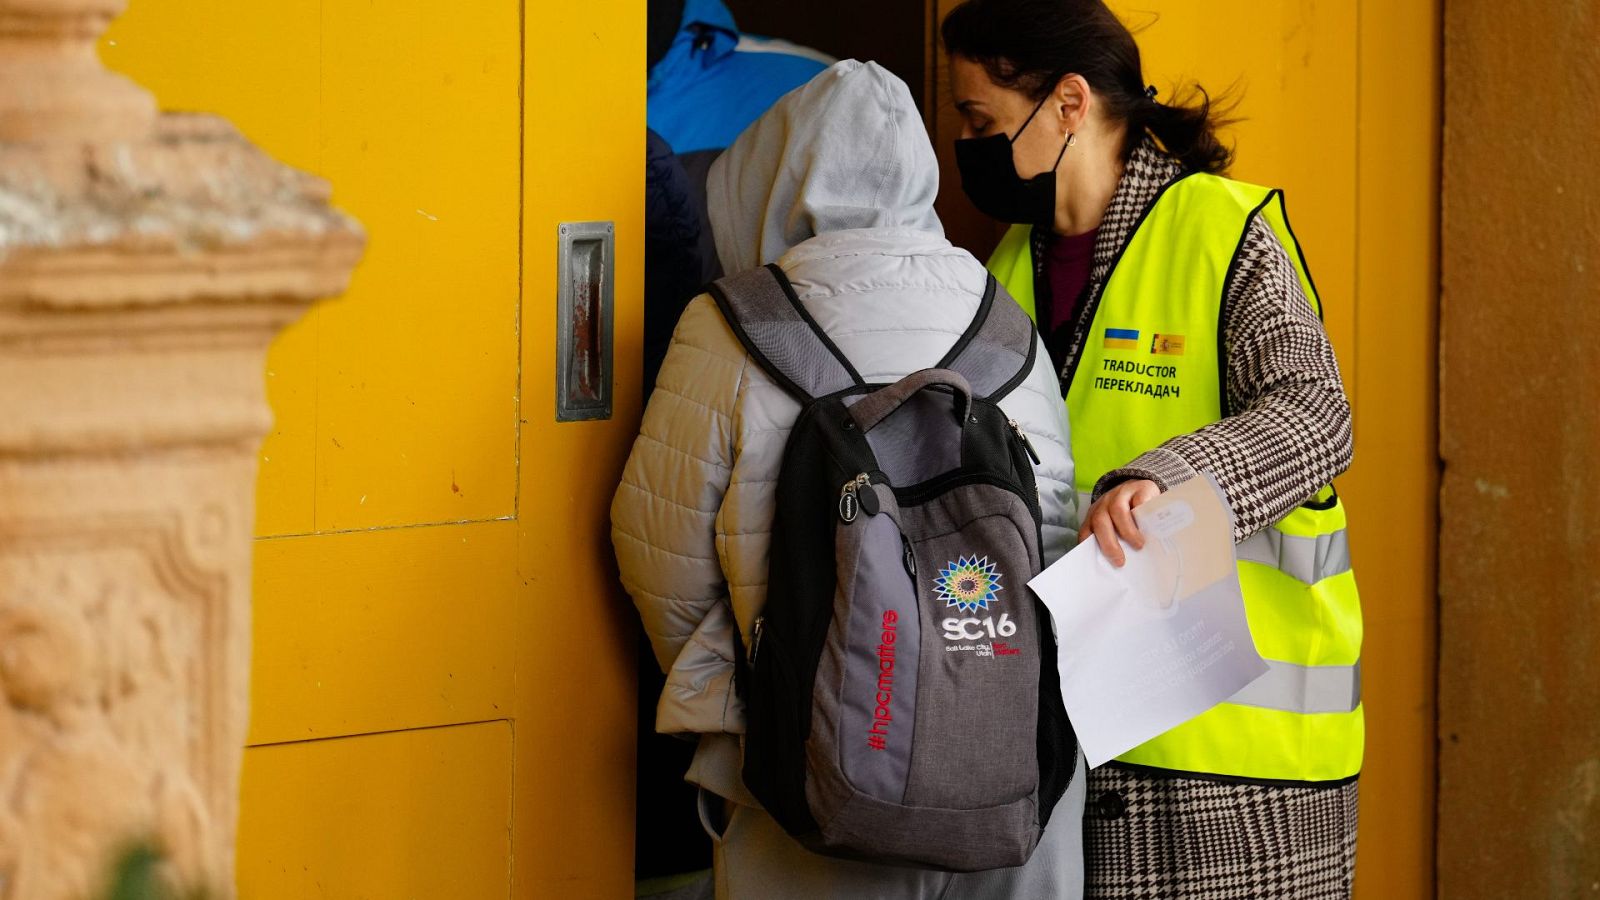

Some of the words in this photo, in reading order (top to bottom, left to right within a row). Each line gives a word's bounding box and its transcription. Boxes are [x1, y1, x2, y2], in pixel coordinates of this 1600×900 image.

[1103, 359, 1177, 378] TRADUCTOR
[1094, 377, 1180, 399] ПЕРЕКЛАДАЧ
[942, 613, 1017, 640] SC16
[867, 609, 899, 751] #hpcmatters
